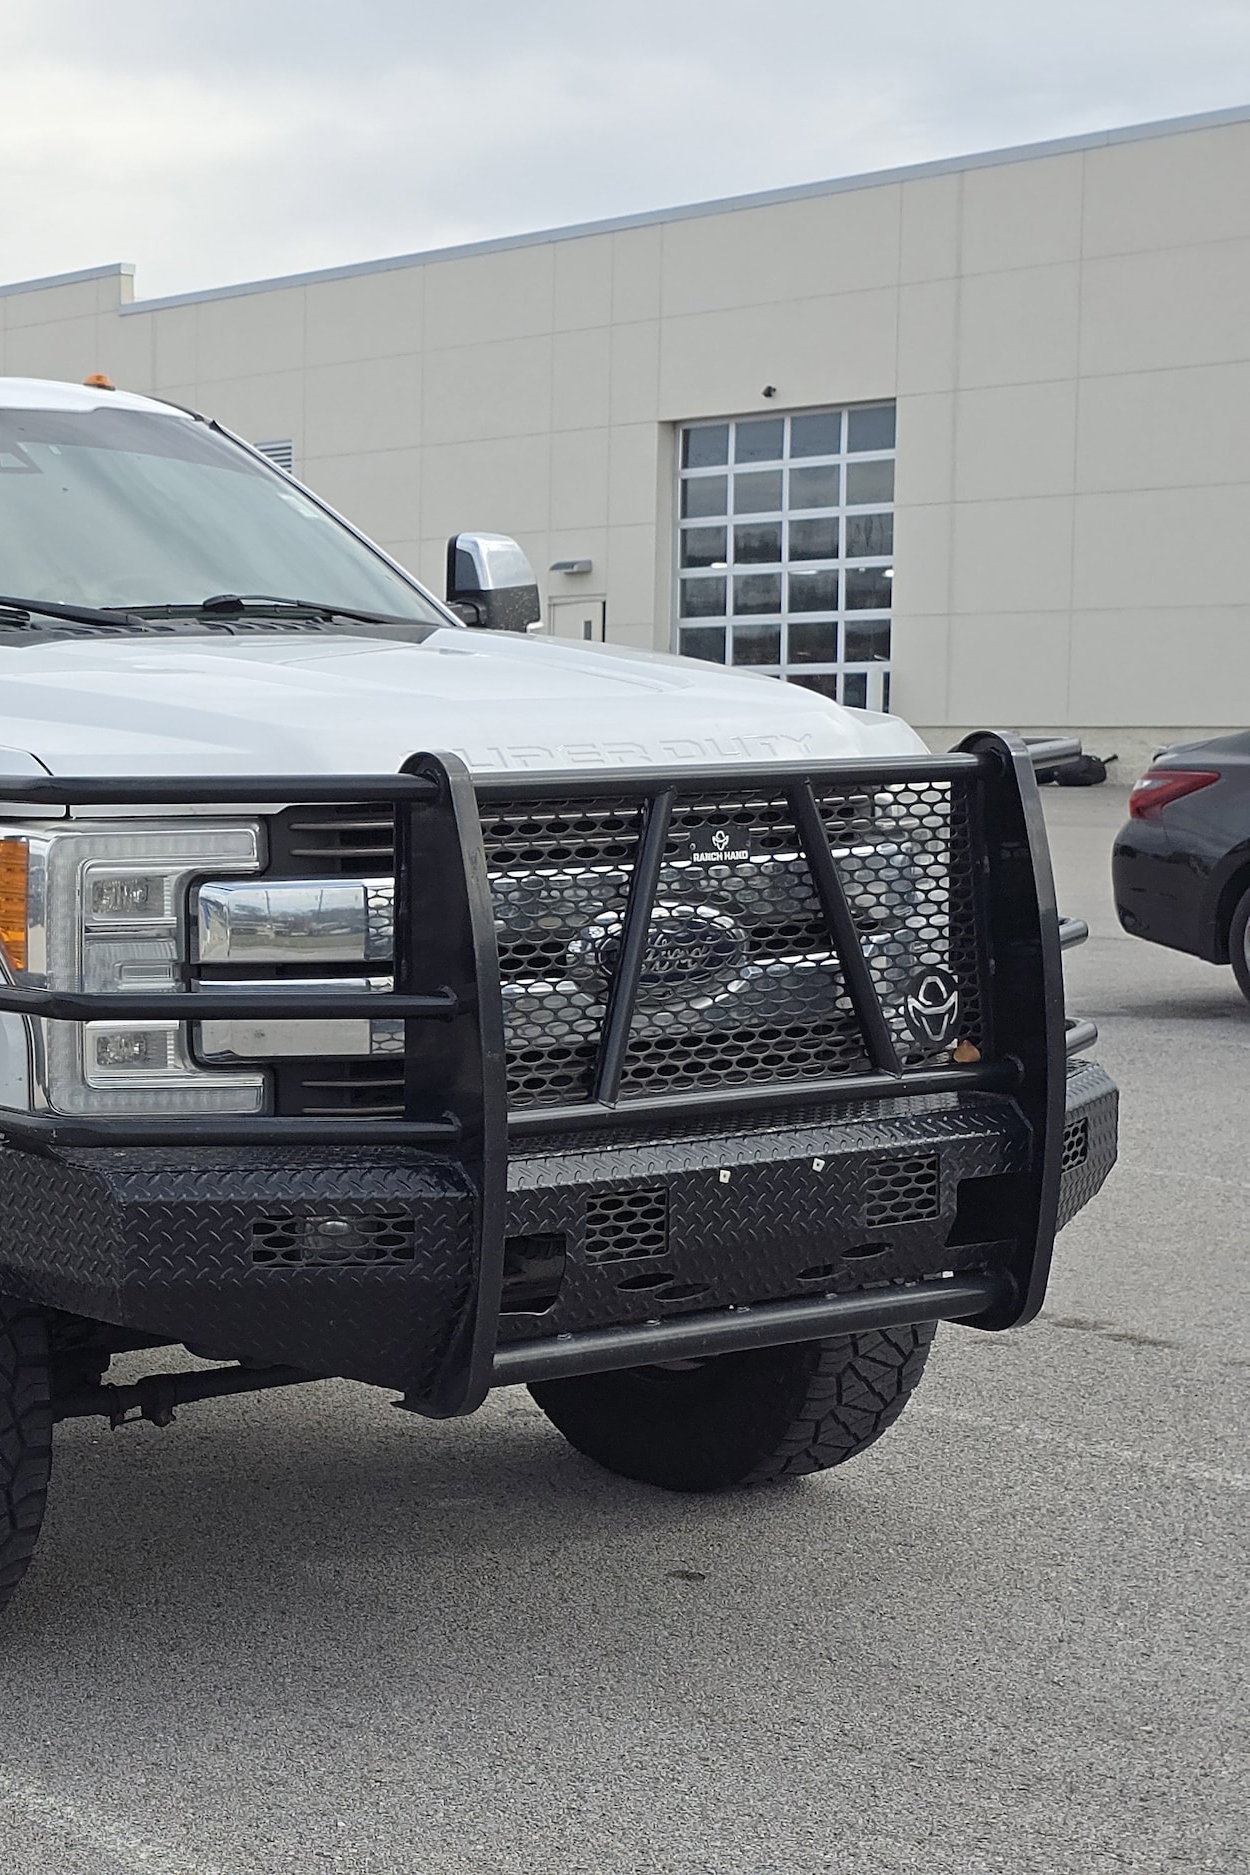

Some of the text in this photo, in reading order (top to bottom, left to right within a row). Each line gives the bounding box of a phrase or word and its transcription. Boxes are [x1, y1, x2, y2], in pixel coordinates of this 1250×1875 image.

[415, 731, 813, 769] UPER DUTY
[692, 850, 749, 863] RANCH HAND
